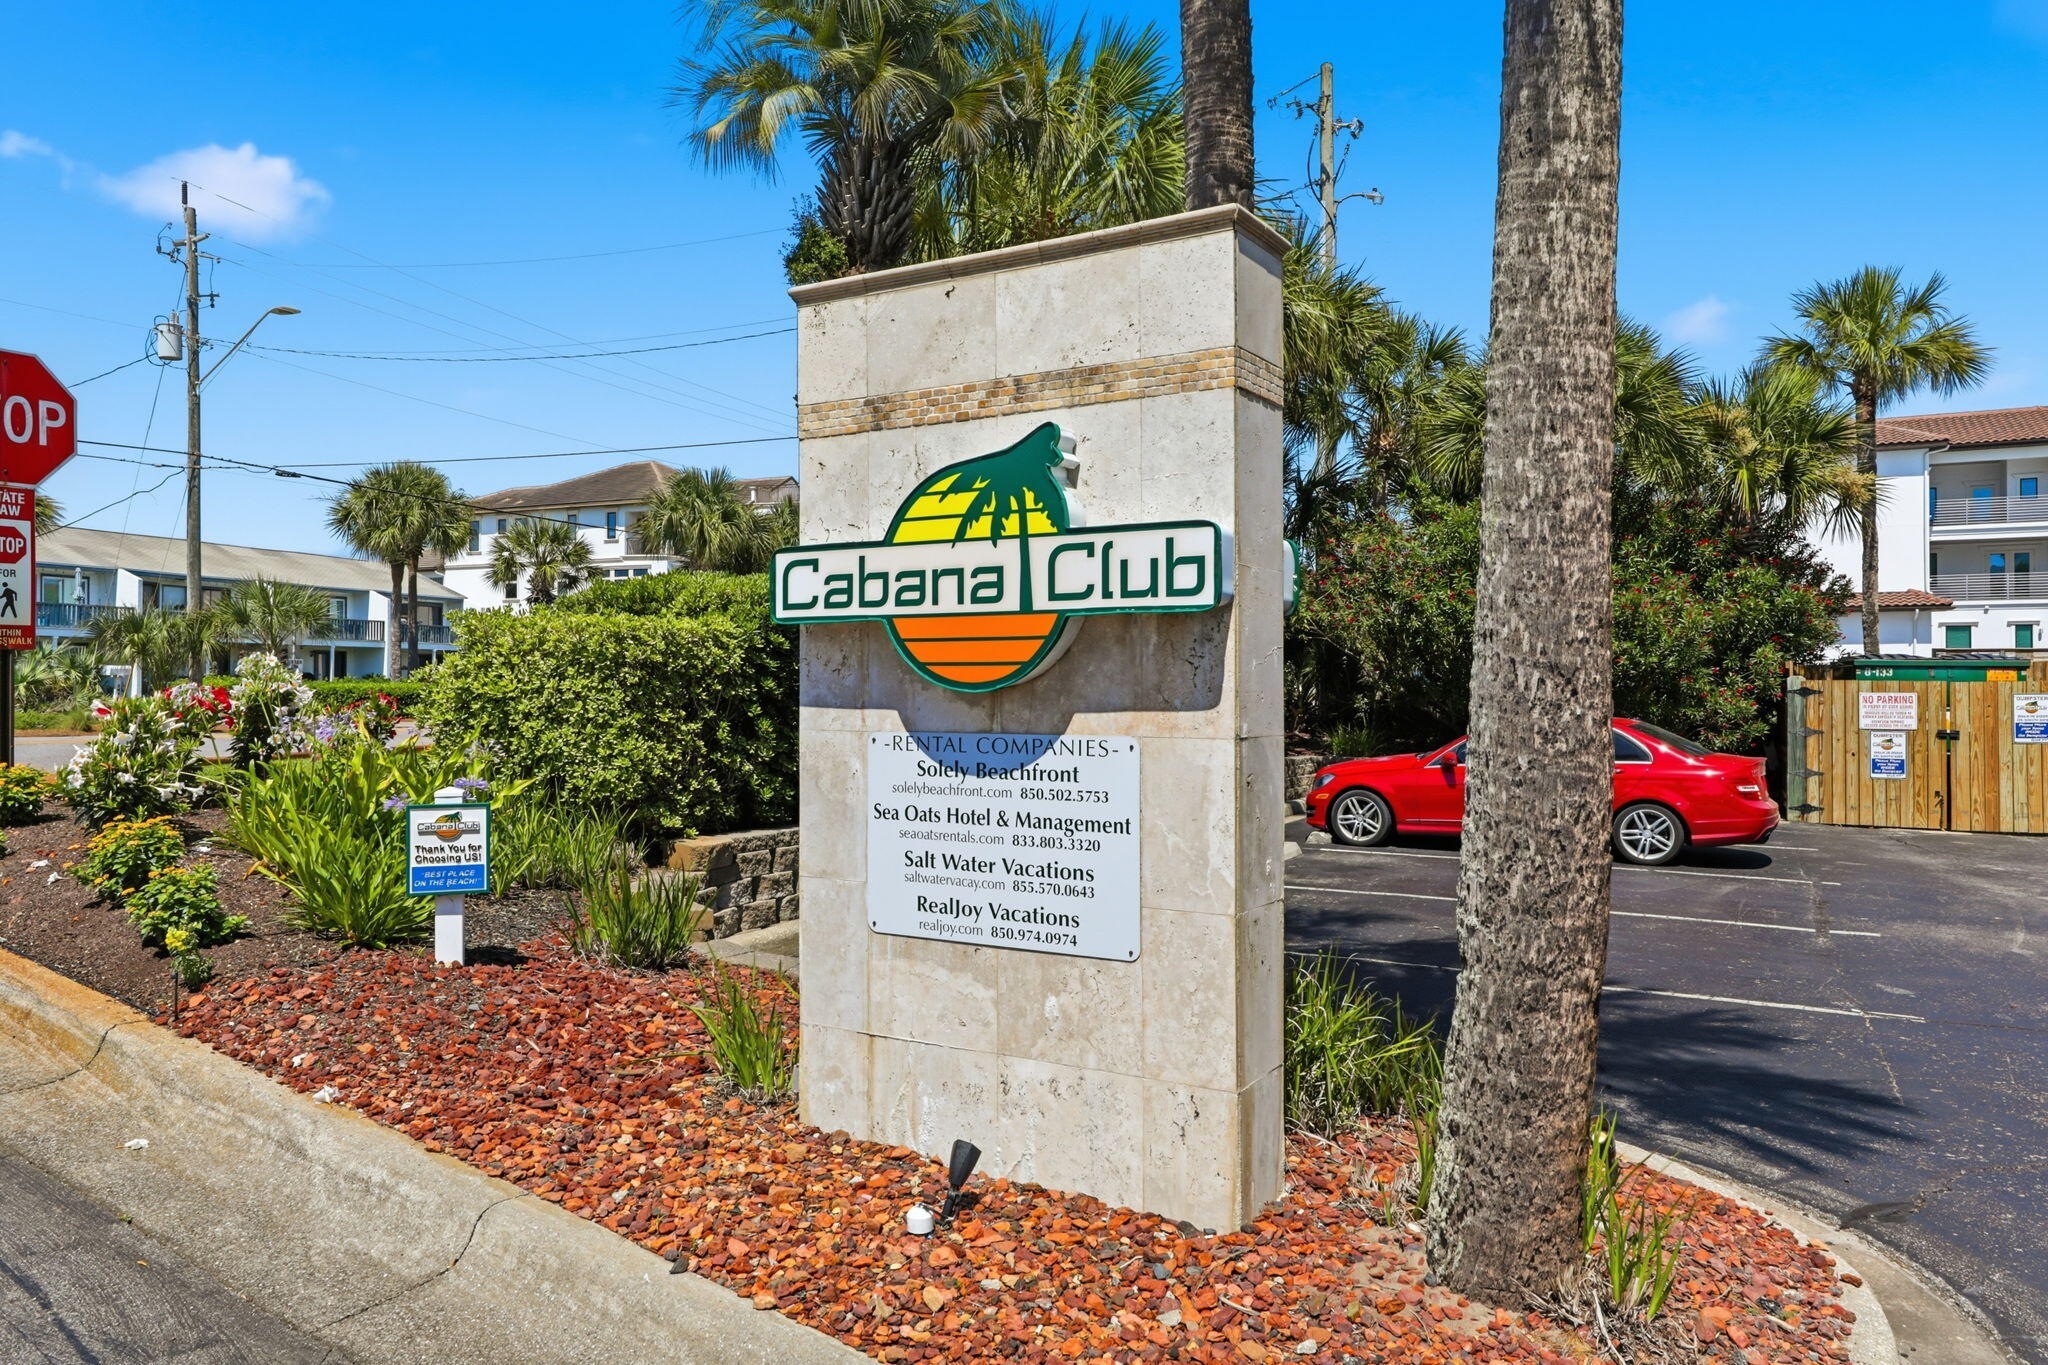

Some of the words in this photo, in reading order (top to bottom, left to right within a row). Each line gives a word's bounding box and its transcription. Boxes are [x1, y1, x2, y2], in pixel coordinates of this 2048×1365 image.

[0, 395, 66, 446] OP
[0, 491, 25, 504] ATE
[0, 504, 20, 516] AW
[0, 536, 24, 553] TOP
[782, 555, 1004, 610] Cabana
[1047, 537, 1206, 601] Club
[1862, 695, 1874, 704] NO
[1877, 695, 1914, 704] PARKING
[917, 759, 970, 784] Solely
[976, 762, 1080, 783] Beachfront
[892, 781, 1012, 798] solelybeachfront.com
[1020, 787, 1109, 803] 850.502.5753
[417, 823, 453, 831] Cabana
[457, 821, 479, 830] Club
[874, 802, 900, 820] Sea
[905, 804, 941, 823] Oats
[947, 807, 991, 826] Hotel
[996, 810, 1009, 827] &
[1015, 811, 1131, 837] Management
[415, 844, 446, 854] Thank
[447, 844, 465, 853] You
[468, 843, 482, 852] for
[899, 829, 1004, 845] seaoatsrentals.com
[1012, 834, 1100, 852] 833.803.3320
[415, 854, 461, 864] Choosing
[904, 850, 936, 869] Salt
[942, 853, 996, 873] Water
[1002, 858, 1095, 882] Vacations
[447, 869, 475, 877] PLACE
[904, 871, 1006, 892] saltwatervacay.com
[1012, 880, 1095, 898] 855.570.0643
[917, 895, 983, 923] RealJoy
[988, 902, 1080, 928] Vacations
[919, 919, 983, 936] realjoy.com
[991, 926, 1078, 946] 850.974.0974
